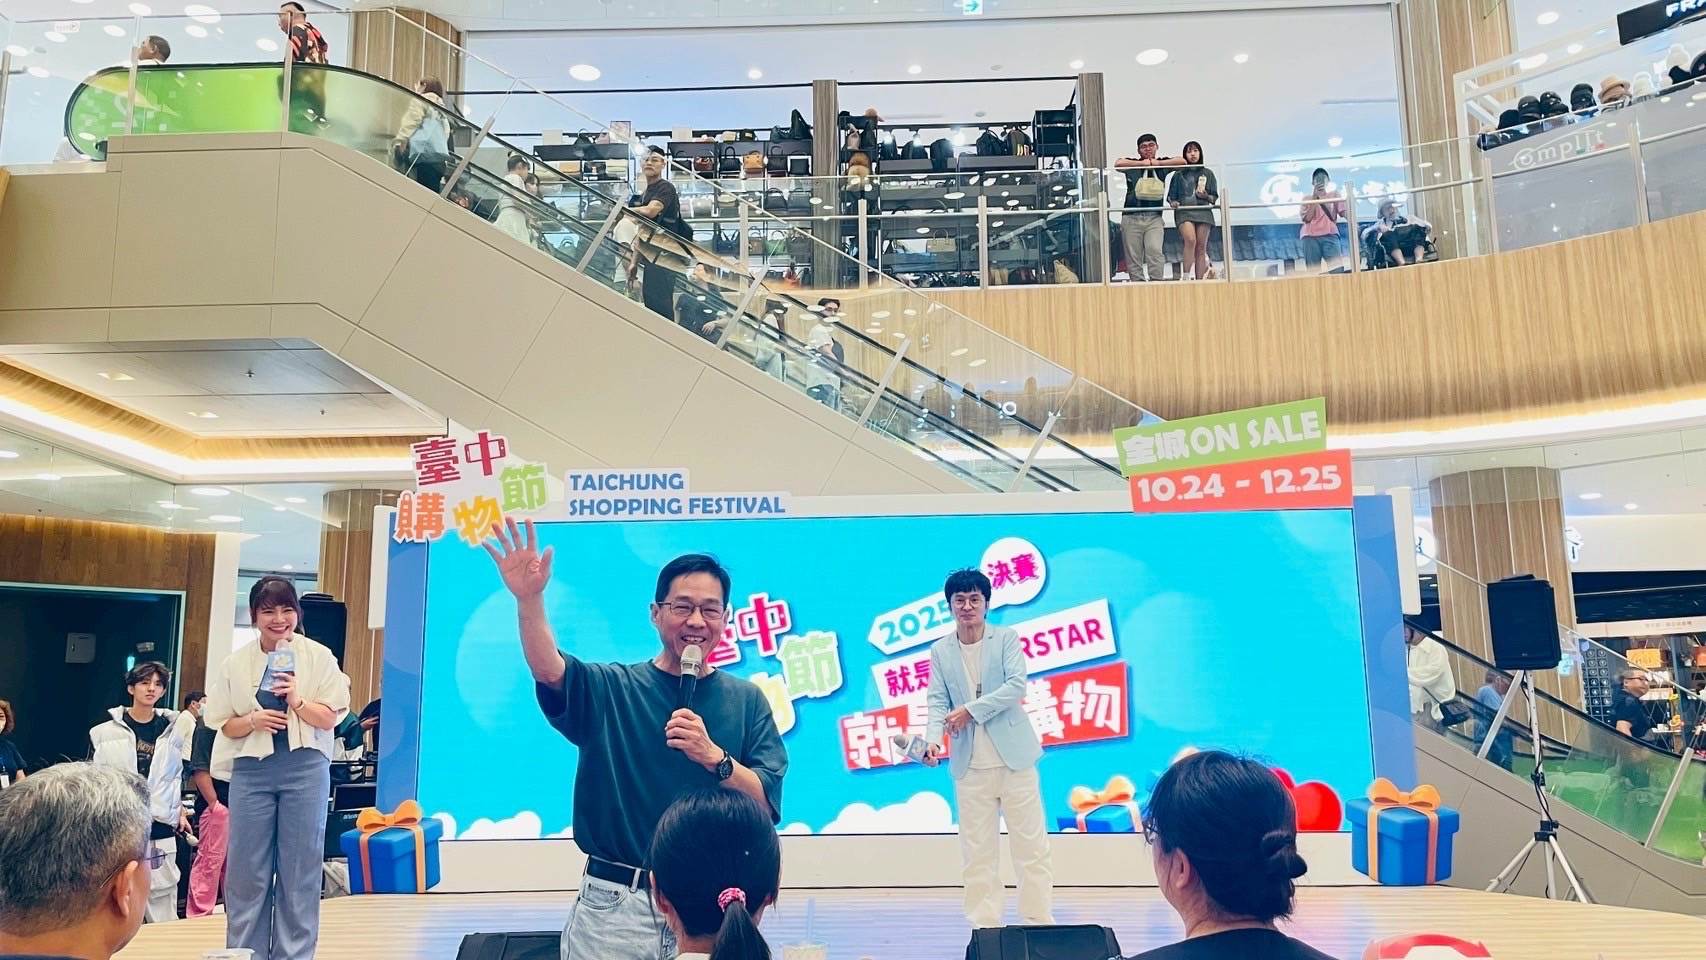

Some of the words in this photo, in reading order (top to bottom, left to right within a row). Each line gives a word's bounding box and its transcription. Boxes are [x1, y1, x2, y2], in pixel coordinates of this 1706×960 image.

[1247, 410, 1322, 448] SALE
[413, 432, 506, 486] 臺中
[569, 473, 685, 491] TAICHUNG
[1137, 473, 1225, 503] 10.24
[1260, 465, 1342, 495] 12.25
[569, 497, 683, 516] SHOPPING
[689, 495, 786, 514] FESTIVAL
[987, 553, 1040, 590] 決賽
[1019, 618, 1105, 659] RSTAR
